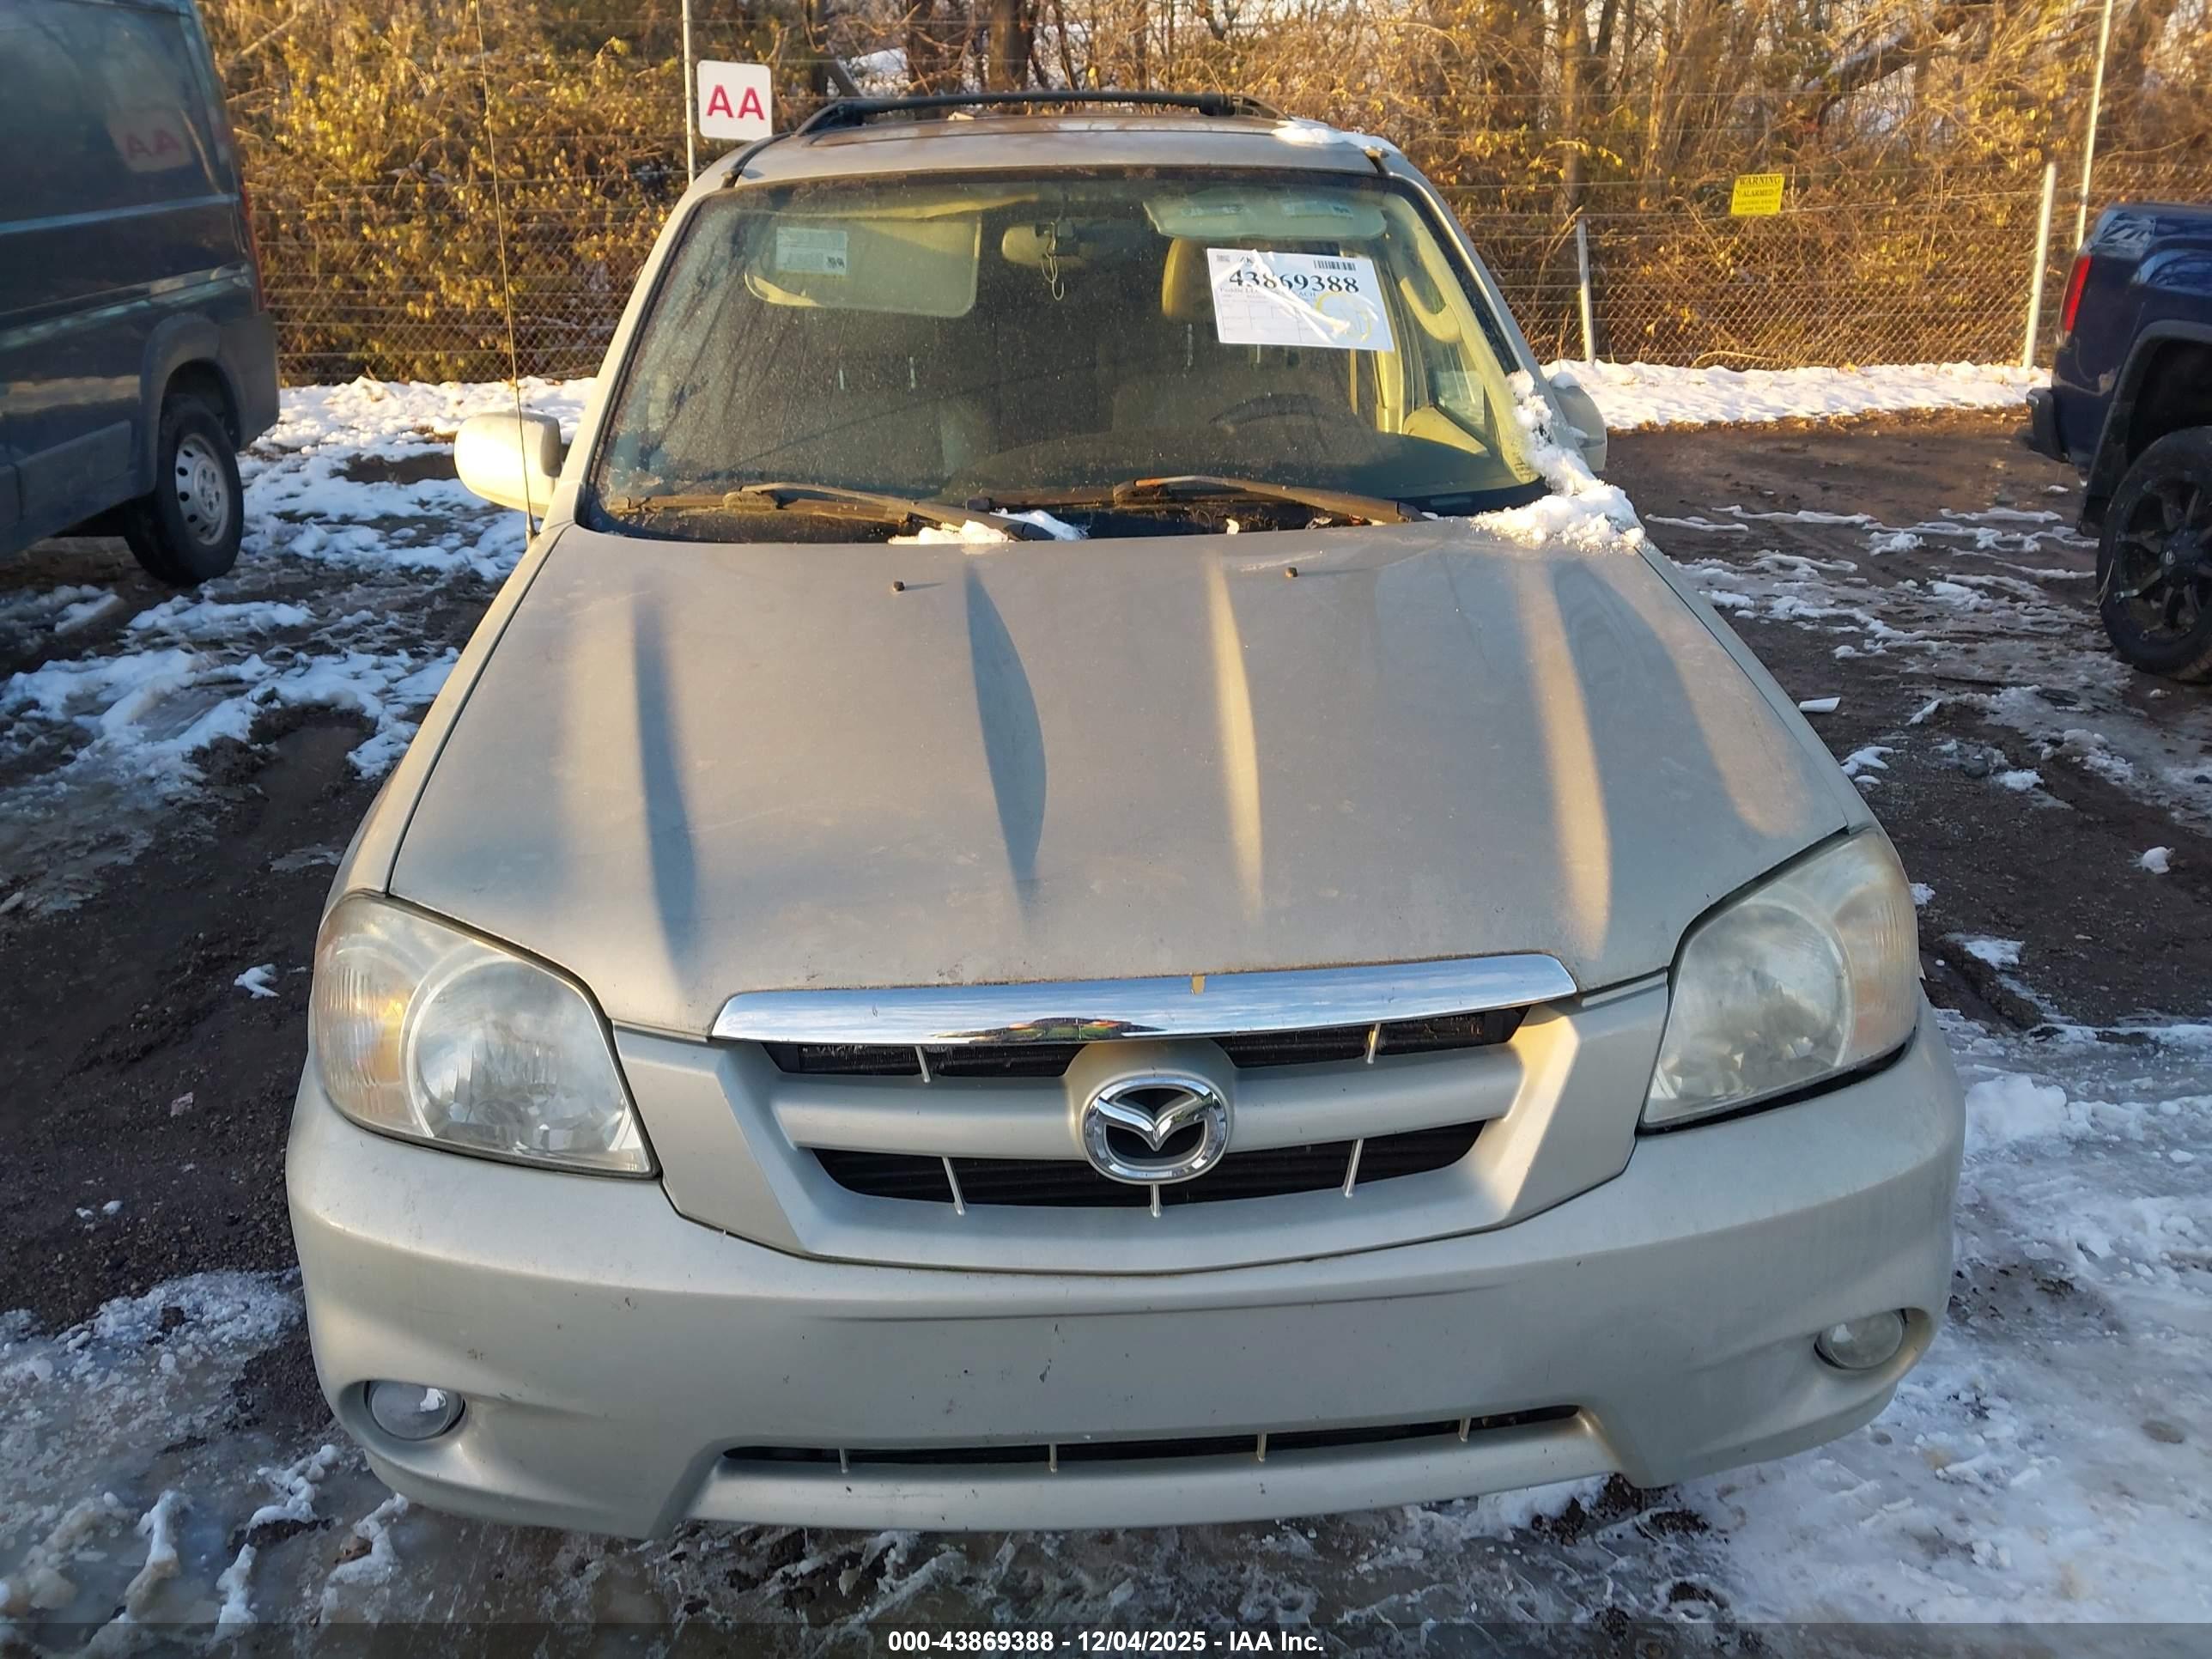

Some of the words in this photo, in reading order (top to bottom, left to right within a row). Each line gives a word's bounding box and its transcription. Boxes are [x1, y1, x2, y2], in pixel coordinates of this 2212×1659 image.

[707, 85, 764, 120] AA
[1739, 176, 1780, 185] WARNING
[1229, 269, 1359, 294] 43869388
